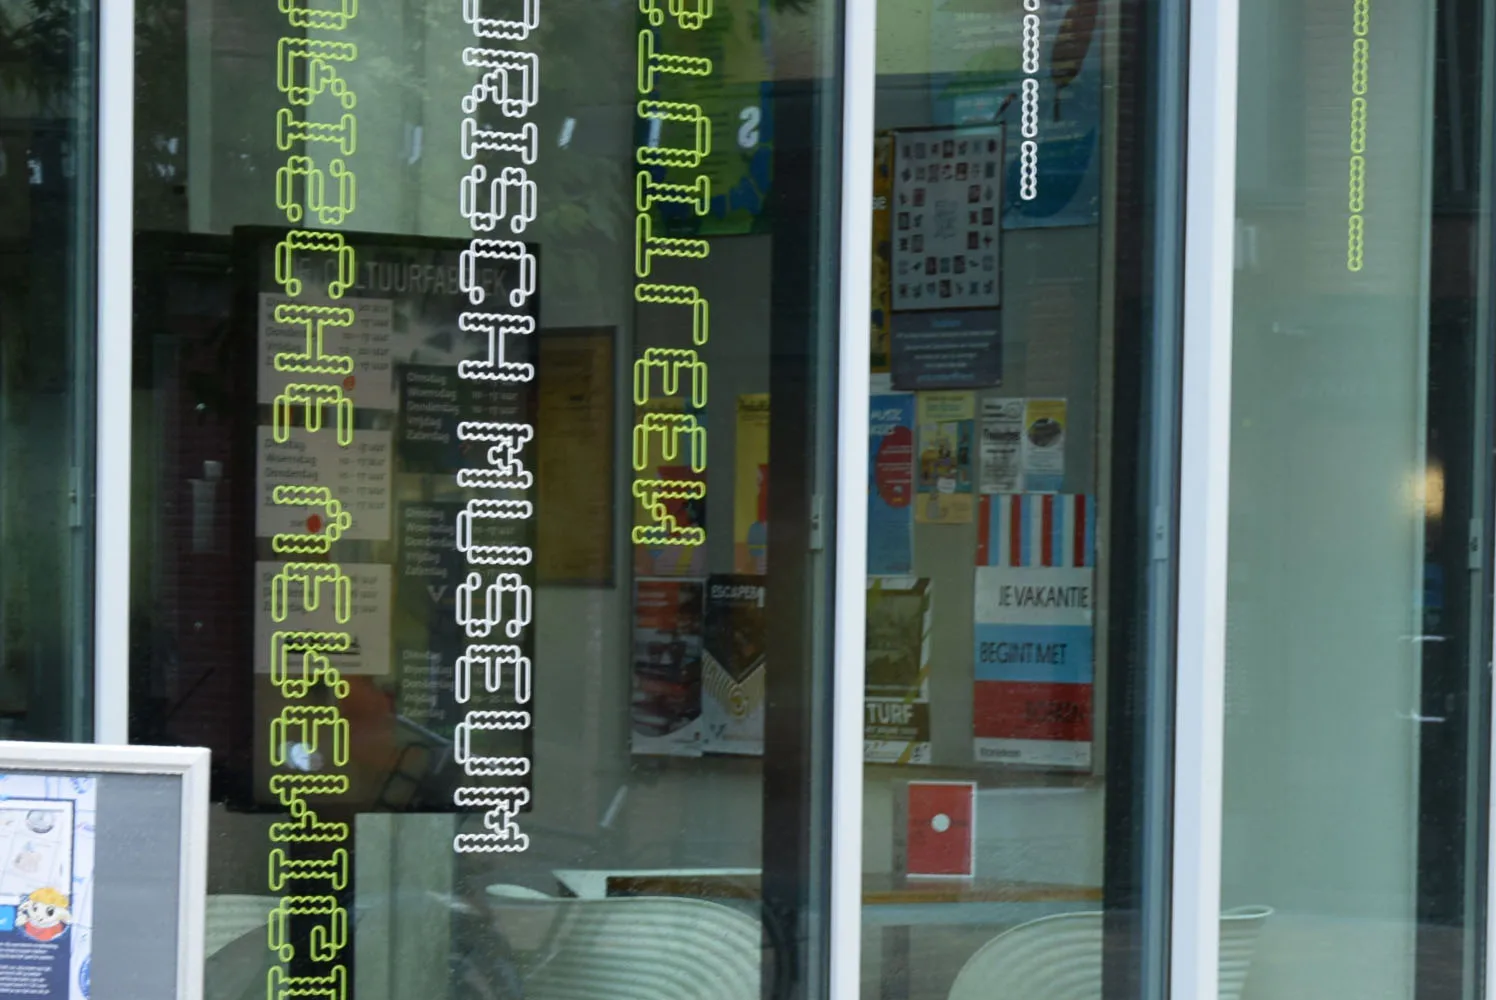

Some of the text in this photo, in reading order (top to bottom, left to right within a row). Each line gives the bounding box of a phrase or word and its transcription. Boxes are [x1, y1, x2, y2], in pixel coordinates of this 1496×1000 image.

[1013, 585, 1090, 609] VAKANTIE
[454, 422, 533, 852] MUSEUM
[1035, 643, 1068, 665] MET
